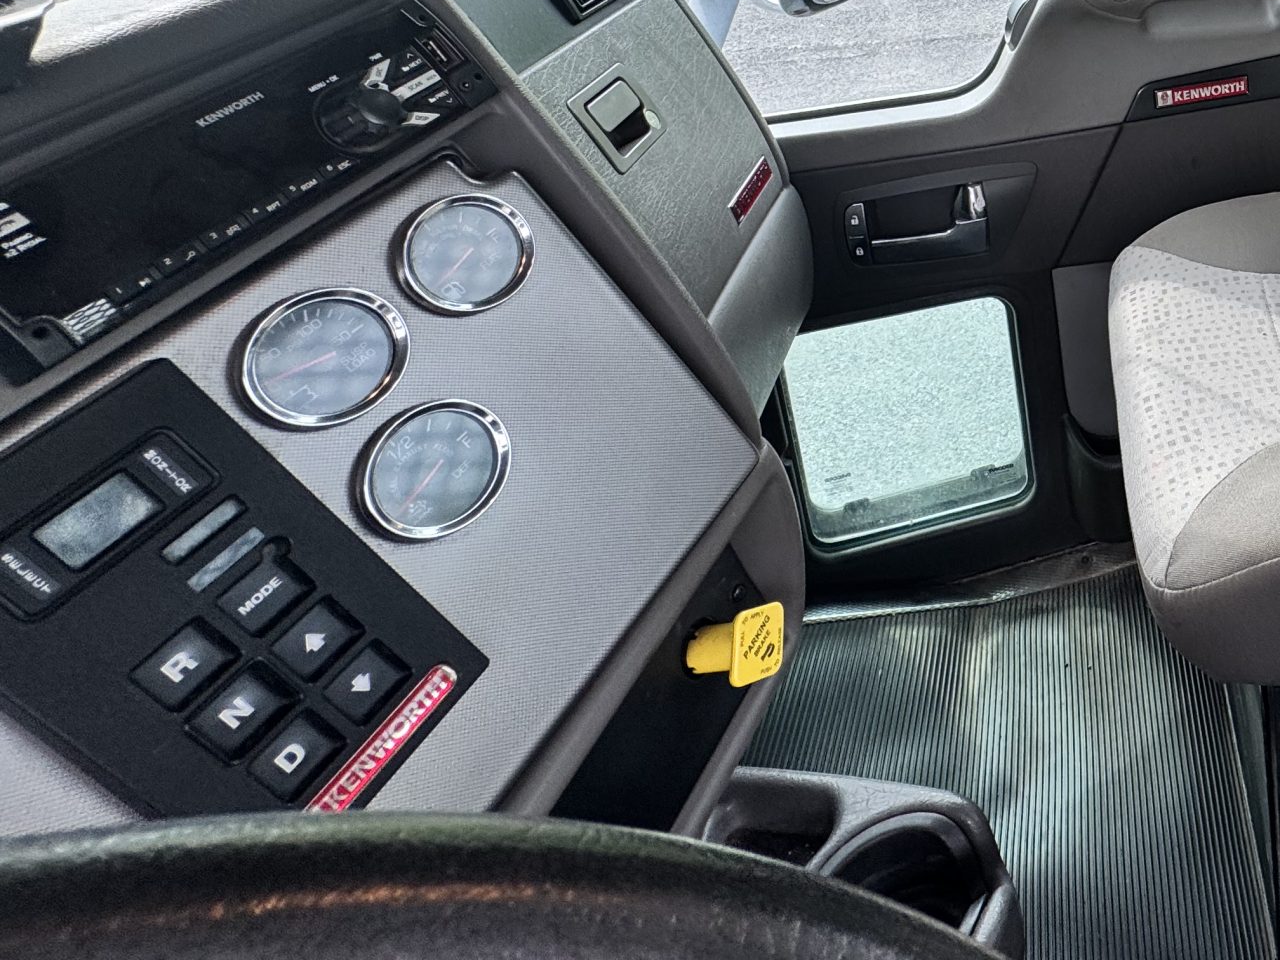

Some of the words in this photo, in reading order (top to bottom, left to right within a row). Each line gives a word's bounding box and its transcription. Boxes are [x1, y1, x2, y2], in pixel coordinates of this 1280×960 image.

[1173, 81, 1245, 102] KENWORTH
[195, 91, 265, 127] KENWORTH
[300, 179, 318, 192] RDM
[266, 200, 281, 213] RPT
[346, 348, 376, 372] LOAD
[143, 449, 194, 494] MONITOR
[1, 553, 51, 594] SELECT
[237, 576, 283, 616] MODE
[743, 614, 771, 660] PARKING
[754, 629, 771, 657] BRAKE
[160, 651, 199, 684] R
[218, 696, 255, 730] N
[273, 743, 306, 774] D
[323, 675, 450, 810] KENWORTH
